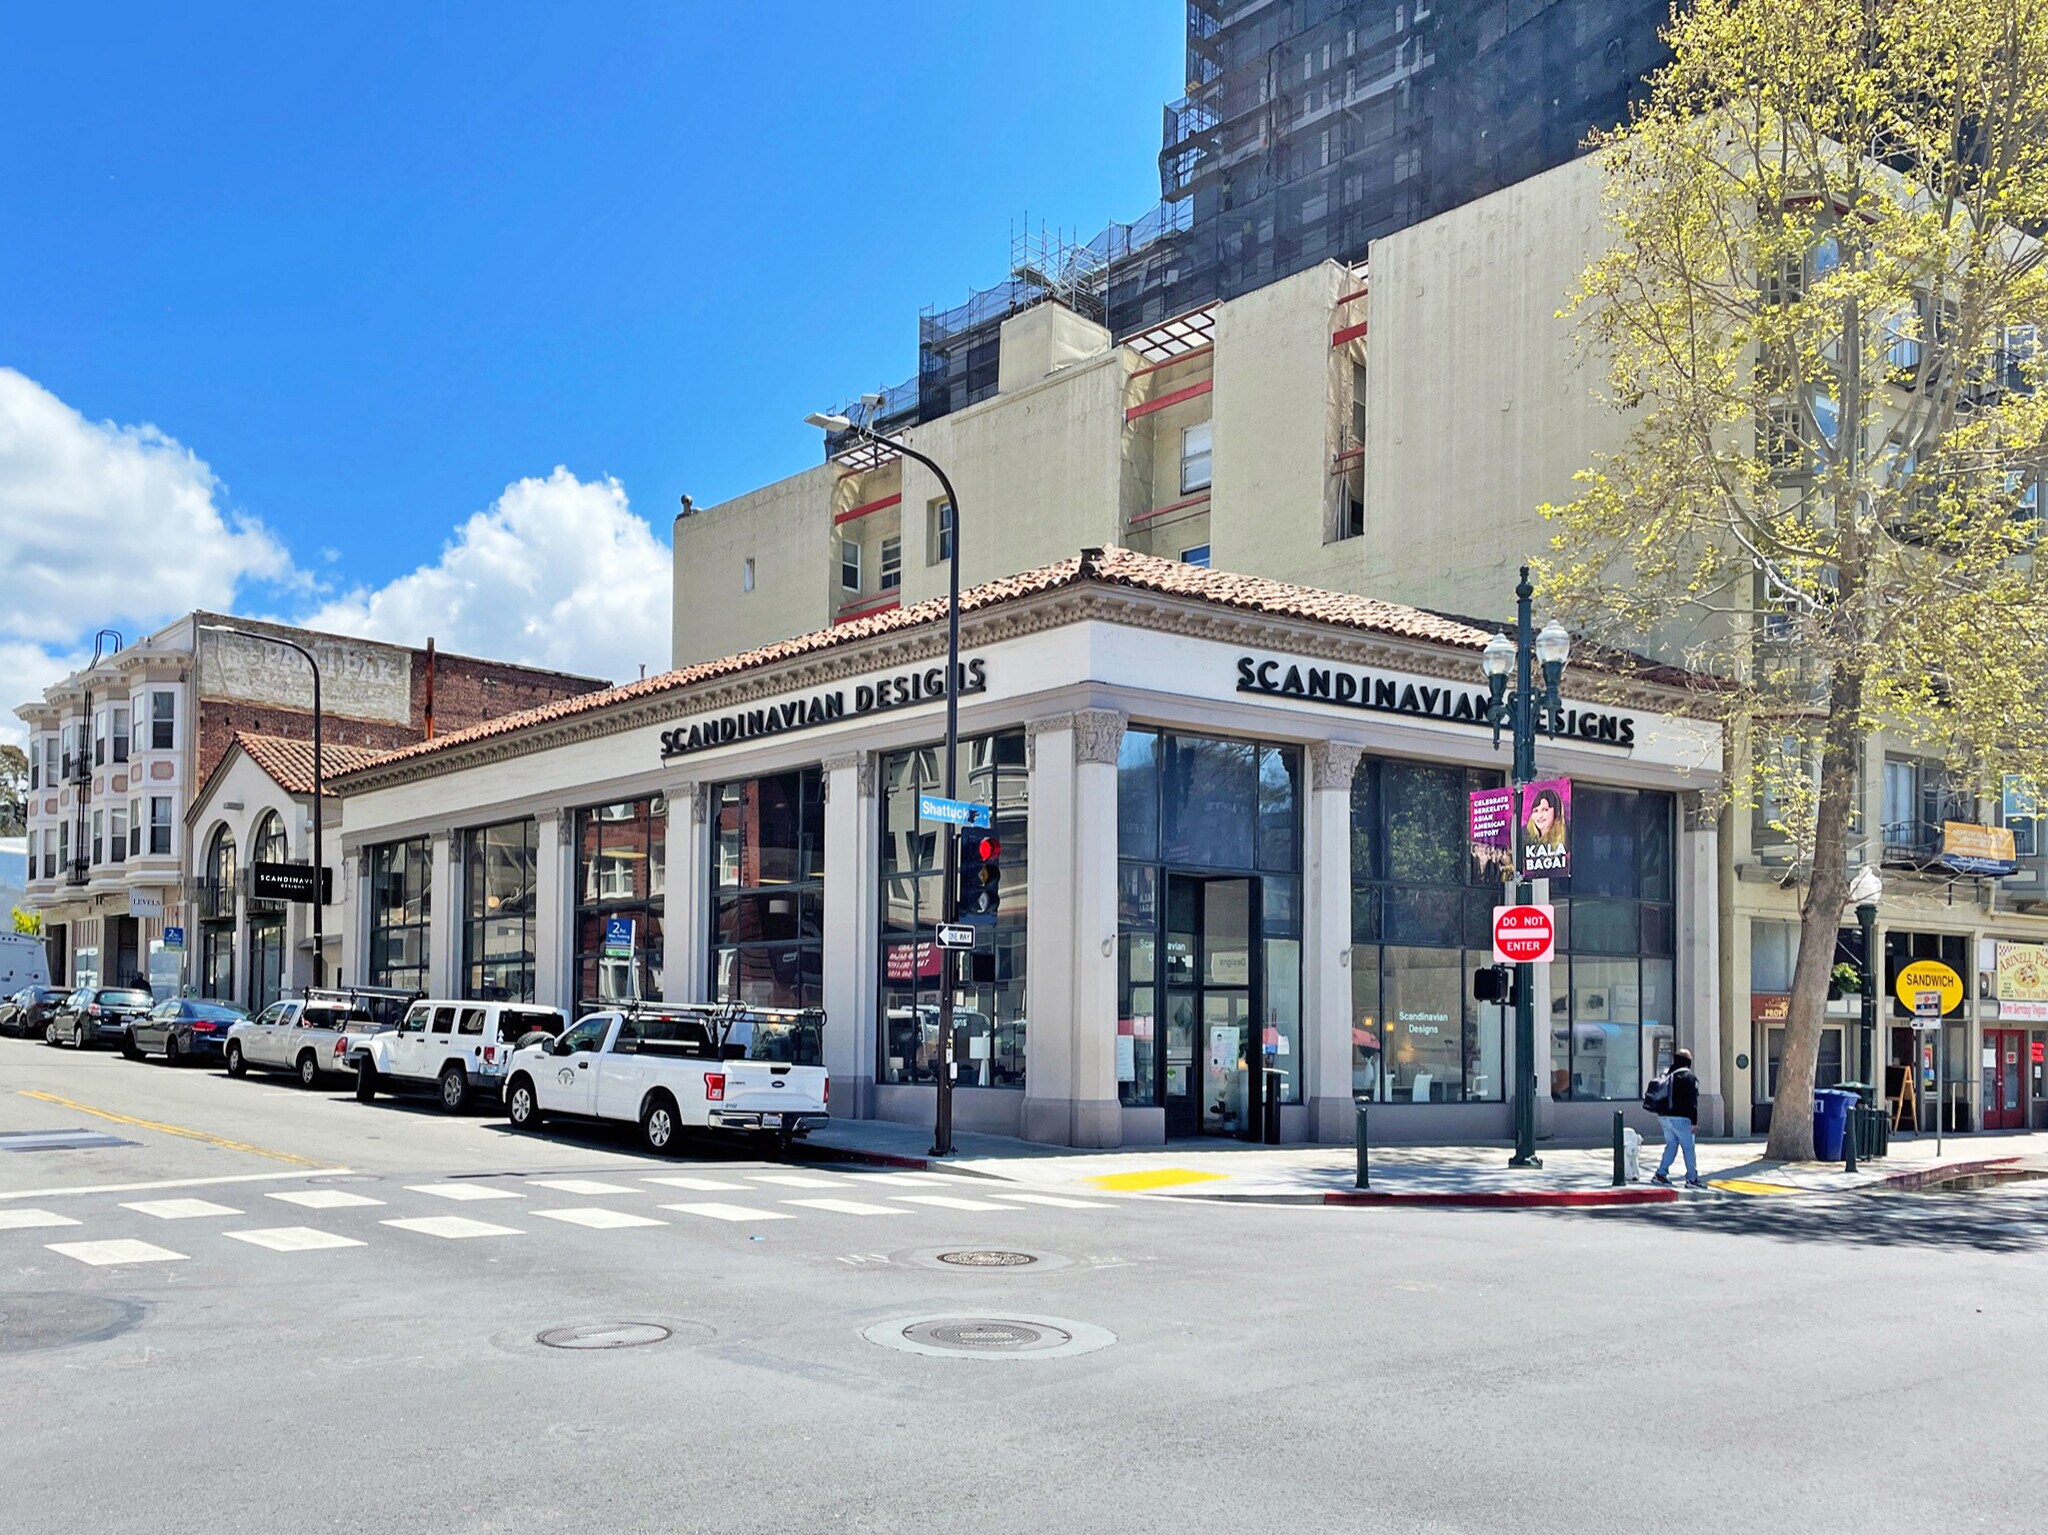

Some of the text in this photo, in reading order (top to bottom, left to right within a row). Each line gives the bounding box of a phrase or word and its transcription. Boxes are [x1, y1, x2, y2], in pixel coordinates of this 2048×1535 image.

[1237, 656, 1635, 743] SCANDINAVIAN ESIGNS
[660, 690, 844, 752] SCANDINAVIAN
[1473, 796, 1509, 807] CELEBRATE
[922, 801, 968, 821] Shattuck
[1473, 803, 1510, 815] BERKELEY'S
[1473, 814, 1494, 823] ASIAN
[1473, 820, 1506, 831] AMERICAN
[1473, 829, 1500, 839] HISTORY
[1525, 842, 1567, 858] KALA
[1525, 856, 1567, 871] BAGAI
[260, 874, 324, 885] SCANDINAVI
[133, 898, 161, 906] LEVELS
[1502, 916, 1544, 926] DO NOT
[613, 922, 620, 934] 2
[948, 931, 971, 941] ONE WAY
[1139, 938, 1186, 951] Scaavian
[1506, 940, 1541, 951] ENTER
[2000, 952, 2033, 975] ARINELL
[1906, 973, 1954, 988] SANDWICH
[929, 1004, 977, 1014] Scnavian
[1399, 1011, 1449, 1022] Scandinavian
[1409, 1024, 1439, 1035] Designs
